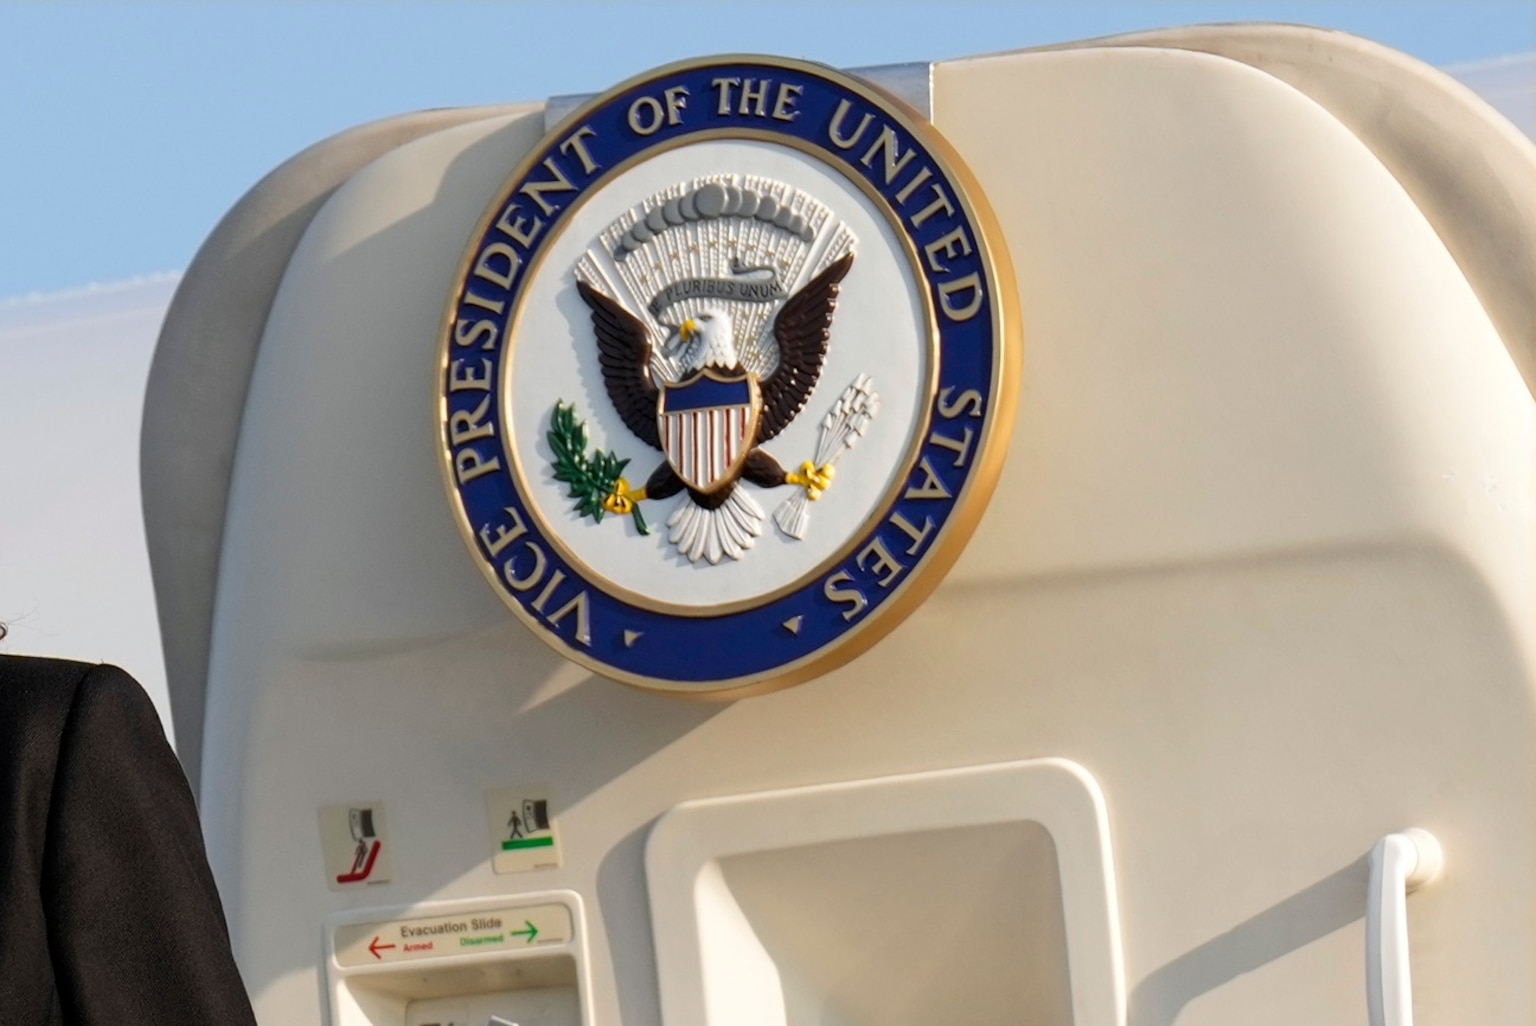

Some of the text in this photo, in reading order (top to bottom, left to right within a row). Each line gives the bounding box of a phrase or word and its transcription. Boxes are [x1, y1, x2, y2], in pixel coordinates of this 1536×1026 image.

[666, 280, 735, 300] PLURIBUS
[739, 283, 783, 298] UNUM
[449, 76, 983, 647] VICE PRESIDENT OF THE UNITED STATES
[400, 918, 503, 938] Evacuation Slide
[403, 941, 434, 952] Armed
[460, 934, 504, 946] Disarmed
